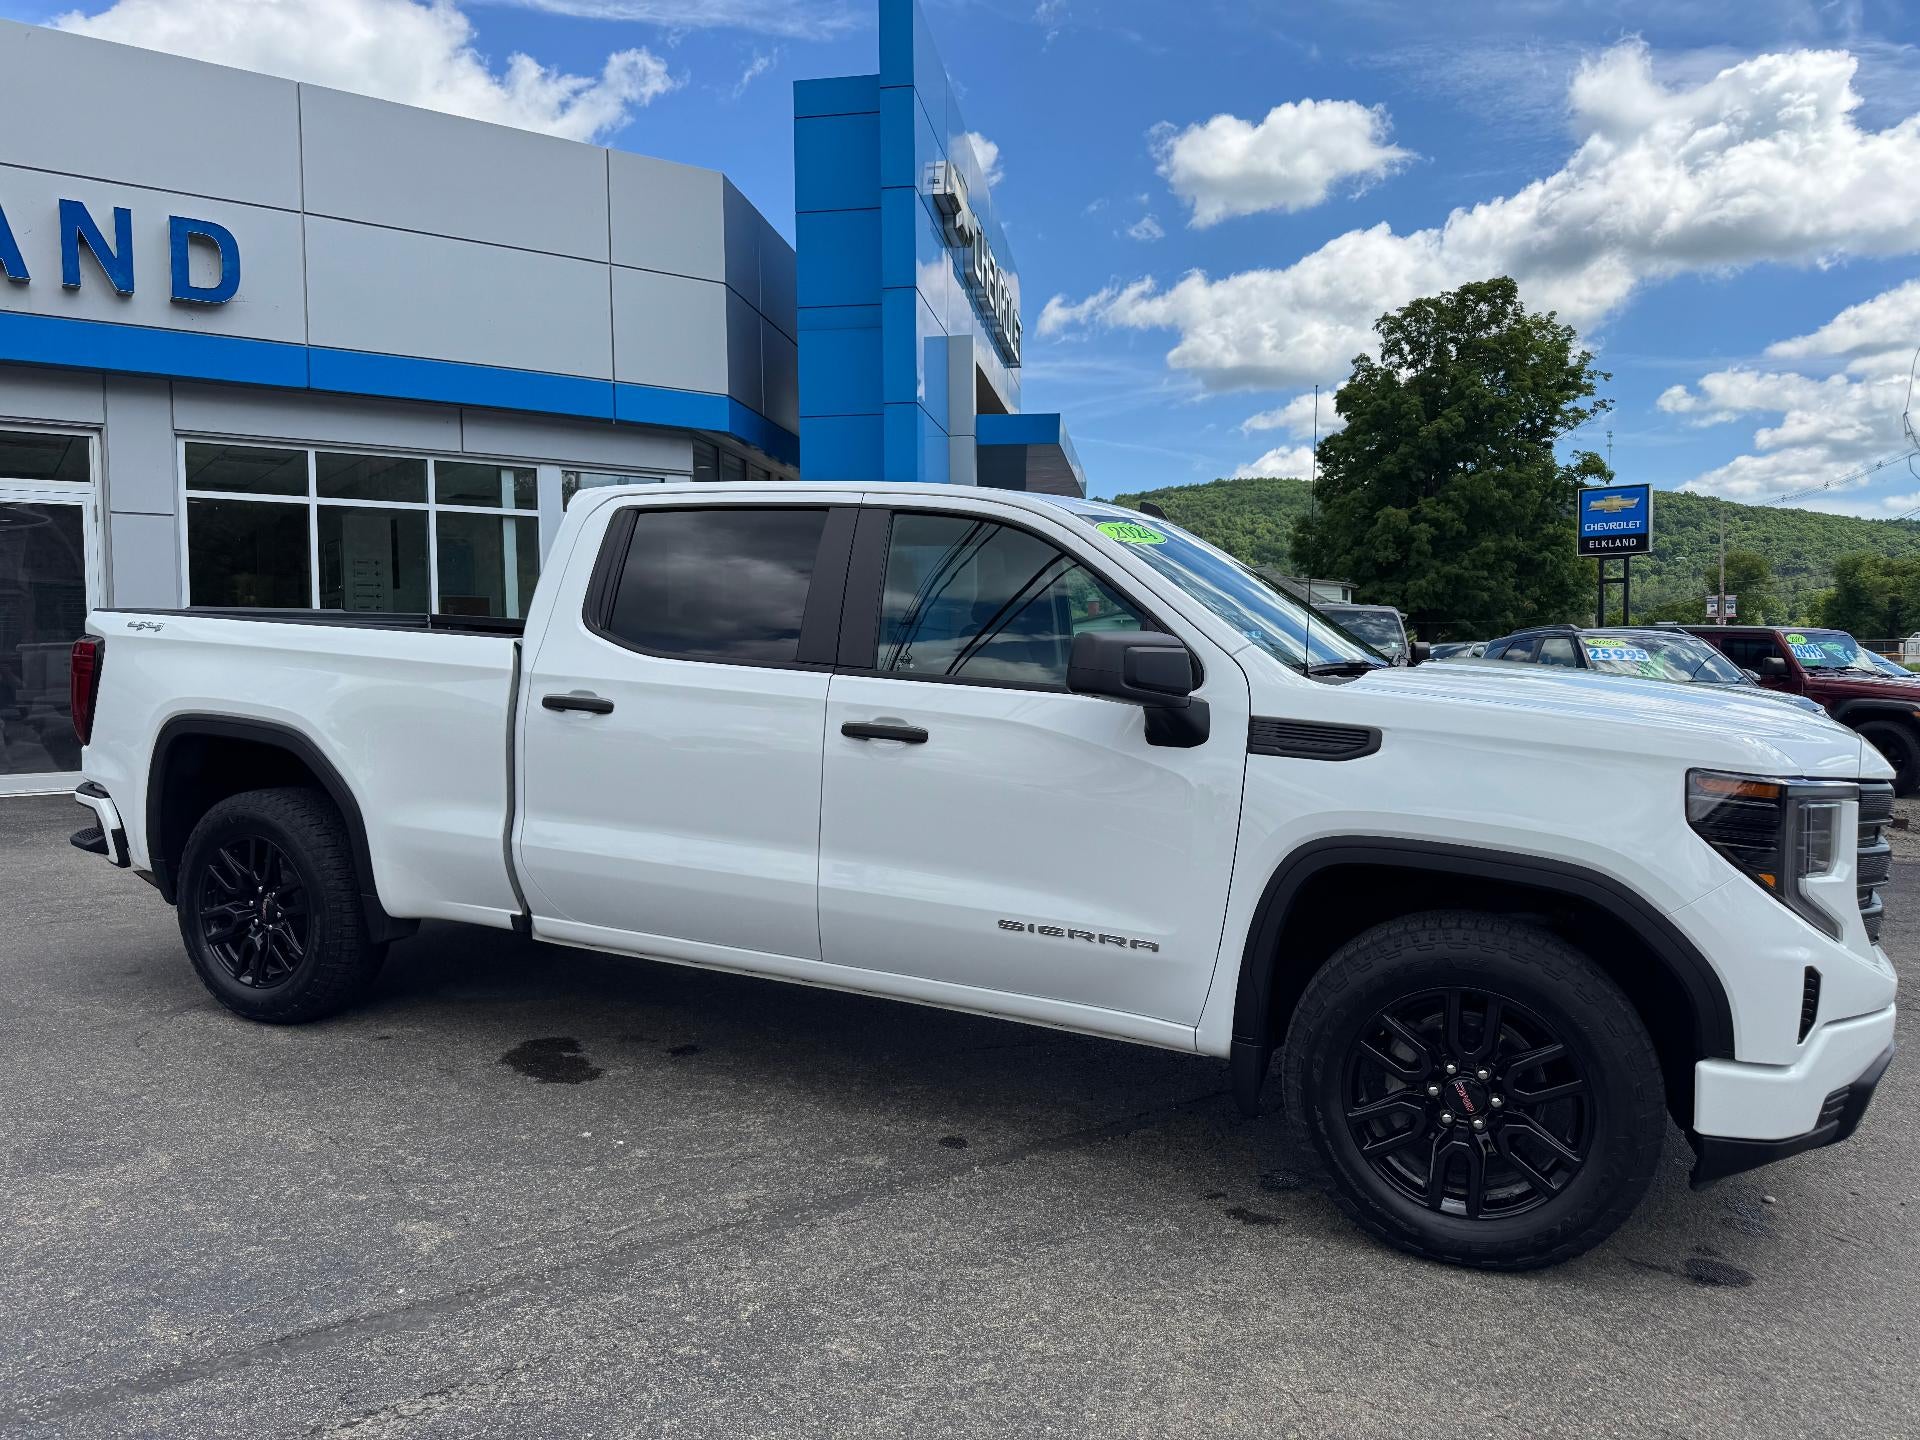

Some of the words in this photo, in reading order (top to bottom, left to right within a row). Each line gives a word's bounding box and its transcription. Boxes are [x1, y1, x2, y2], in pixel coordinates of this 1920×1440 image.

[970, 211, 1023, 367] CHEVROLET
[1584, 520, 1642, 531] CHEVROLET
[1589, 538, 1637, 549] ELKLAND
[1588, 649, 1648, 660] 25995
[998, 919, 1159, 952] SIERRA
